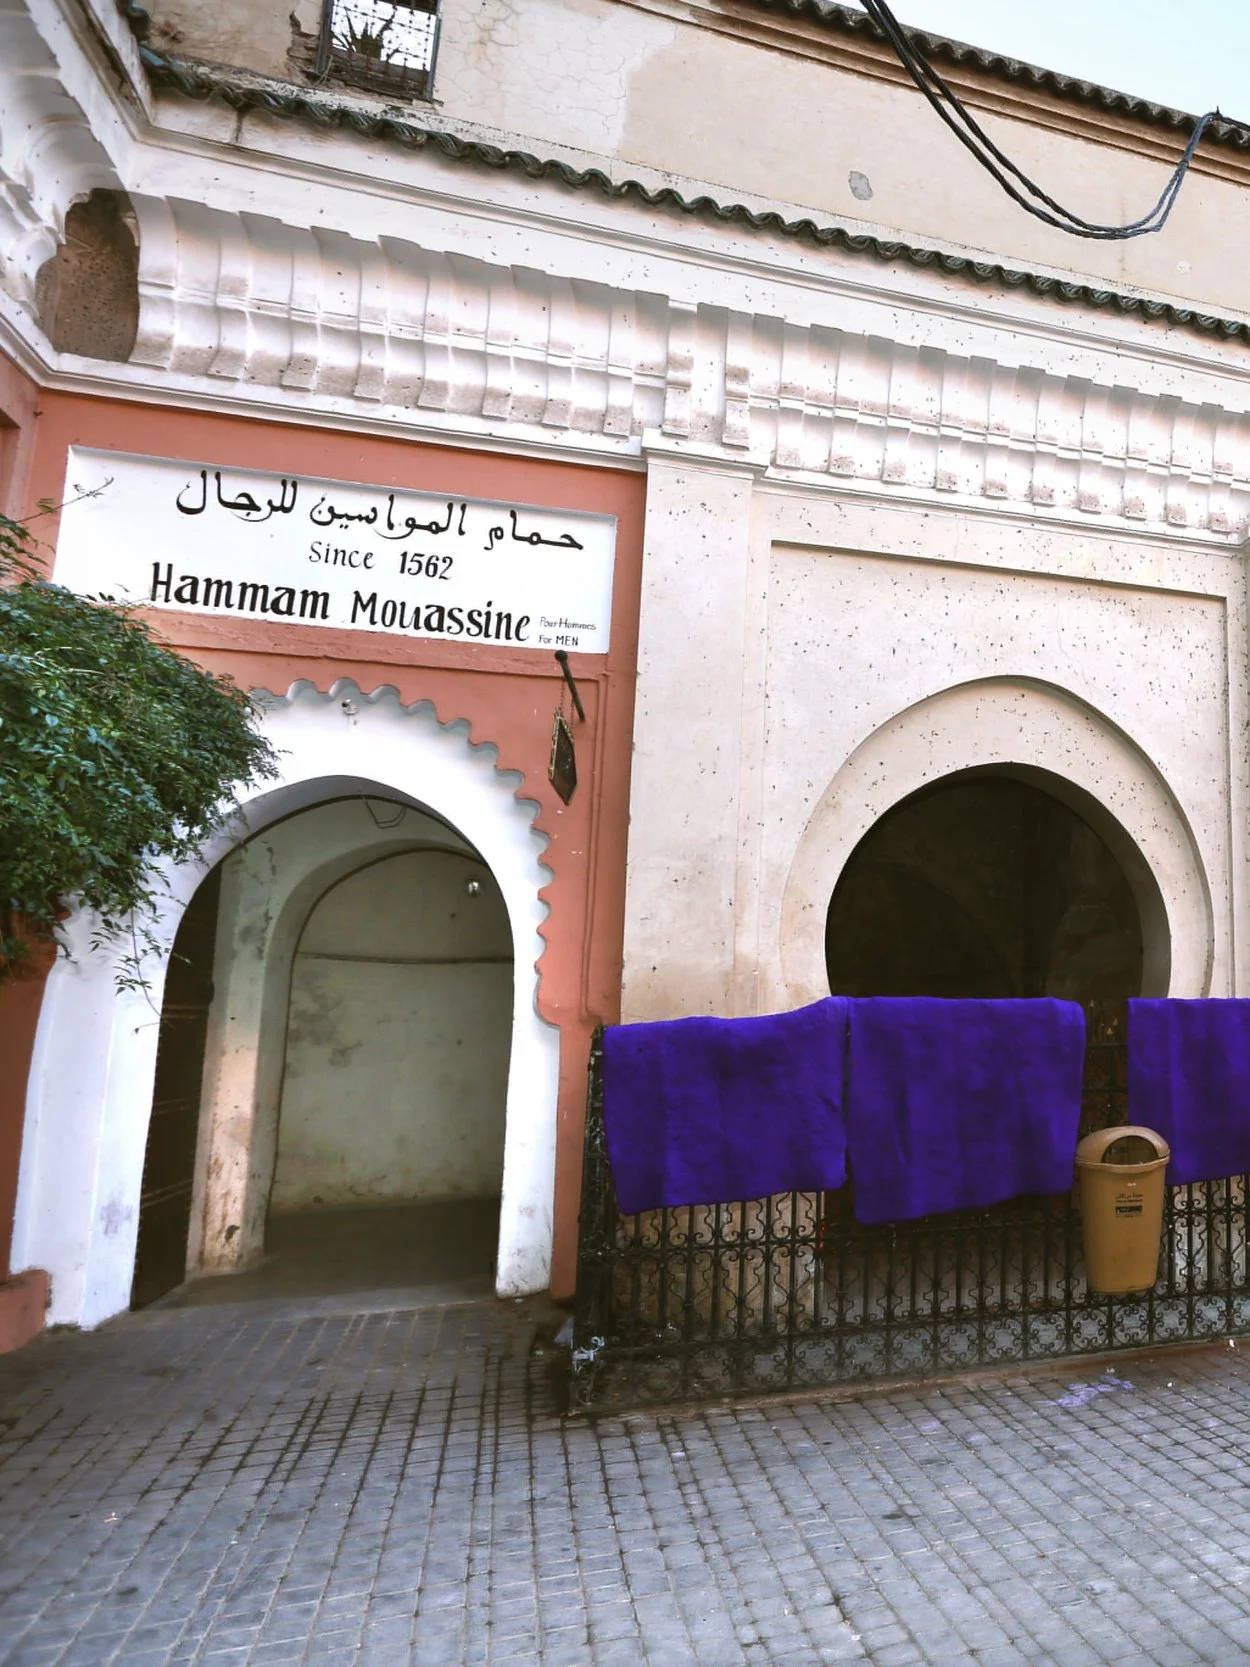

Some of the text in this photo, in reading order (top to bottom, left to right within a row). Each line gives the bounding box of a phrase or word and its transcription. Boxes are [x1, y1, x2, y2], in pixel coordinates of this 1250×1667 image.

[176, 469, 584, 550] حمام المواسين للرجال
[308, 541, 454, 580] Since 1562
[150, 561, 531, 642] Hammam Mouassine
[538, 634, 579, 647] For MEN
[539, 616, 597, 631] Pour Hommes
